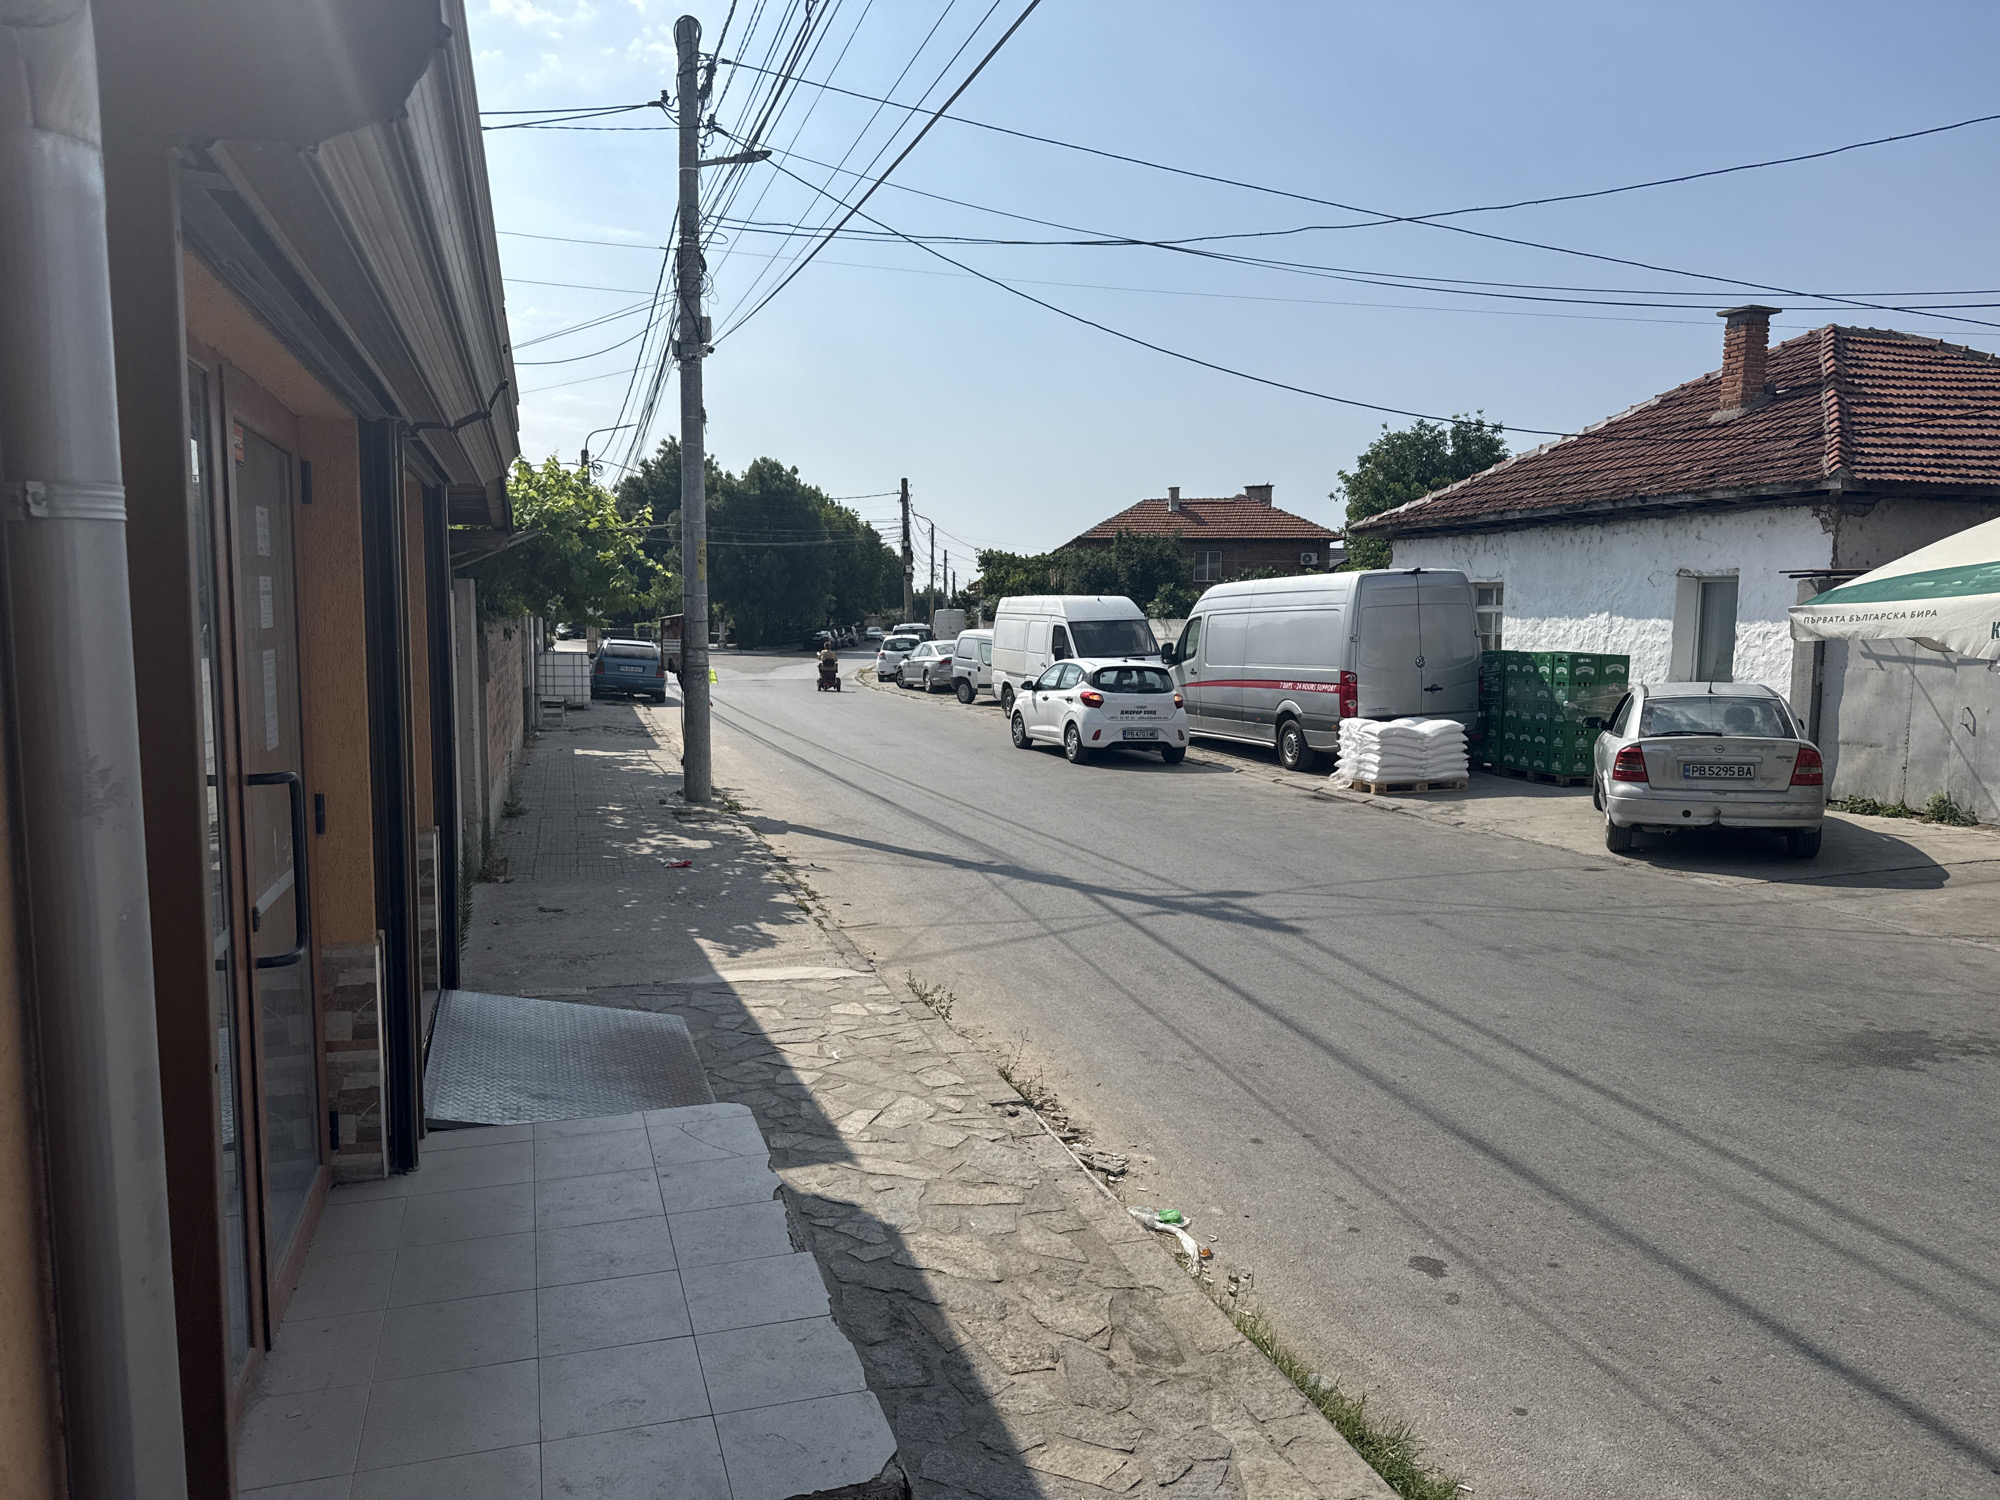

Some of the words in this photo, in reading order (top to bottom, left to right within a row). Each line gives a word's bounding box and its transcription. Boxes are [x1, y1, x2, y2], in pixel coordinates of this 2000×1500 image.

[1803, 615, 1846, 624] ПЪРВАТА
[1849, 611, 1907, 622] БЪЛГАРСКА
[1910, 609, 1938, 619] БИРА
[1302, 683, 1317, 691] HOURS
[1316, 684, 1337, 692] SUPPORT
[1708, 766, 1735, 777] 5295
